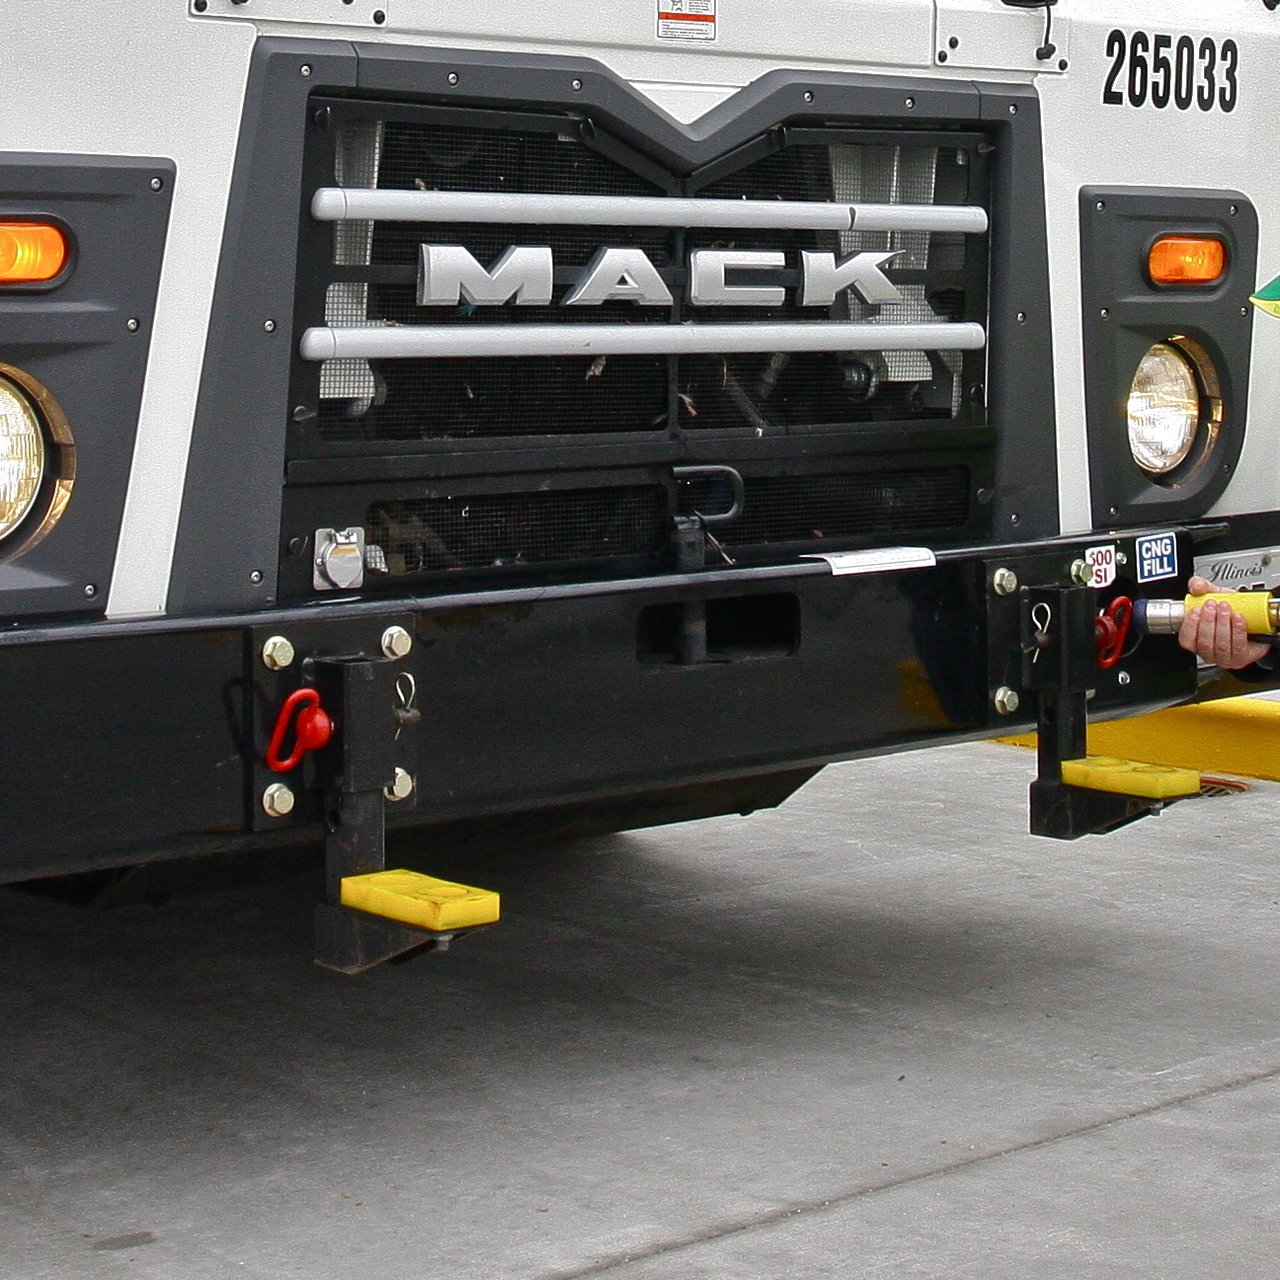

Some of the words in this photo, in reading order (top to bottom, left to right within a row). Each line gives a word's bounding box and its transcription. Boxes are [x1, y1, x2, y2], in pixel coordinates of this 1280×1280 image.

[1103, 29, 1238, 113] 265033
[416, 243, 907, 306] MACK
[1141, 538, 1172, 558] CNG
[1143, 557, 1173, 577] FILL
[1209, 561, 1264, 583] Illinois
